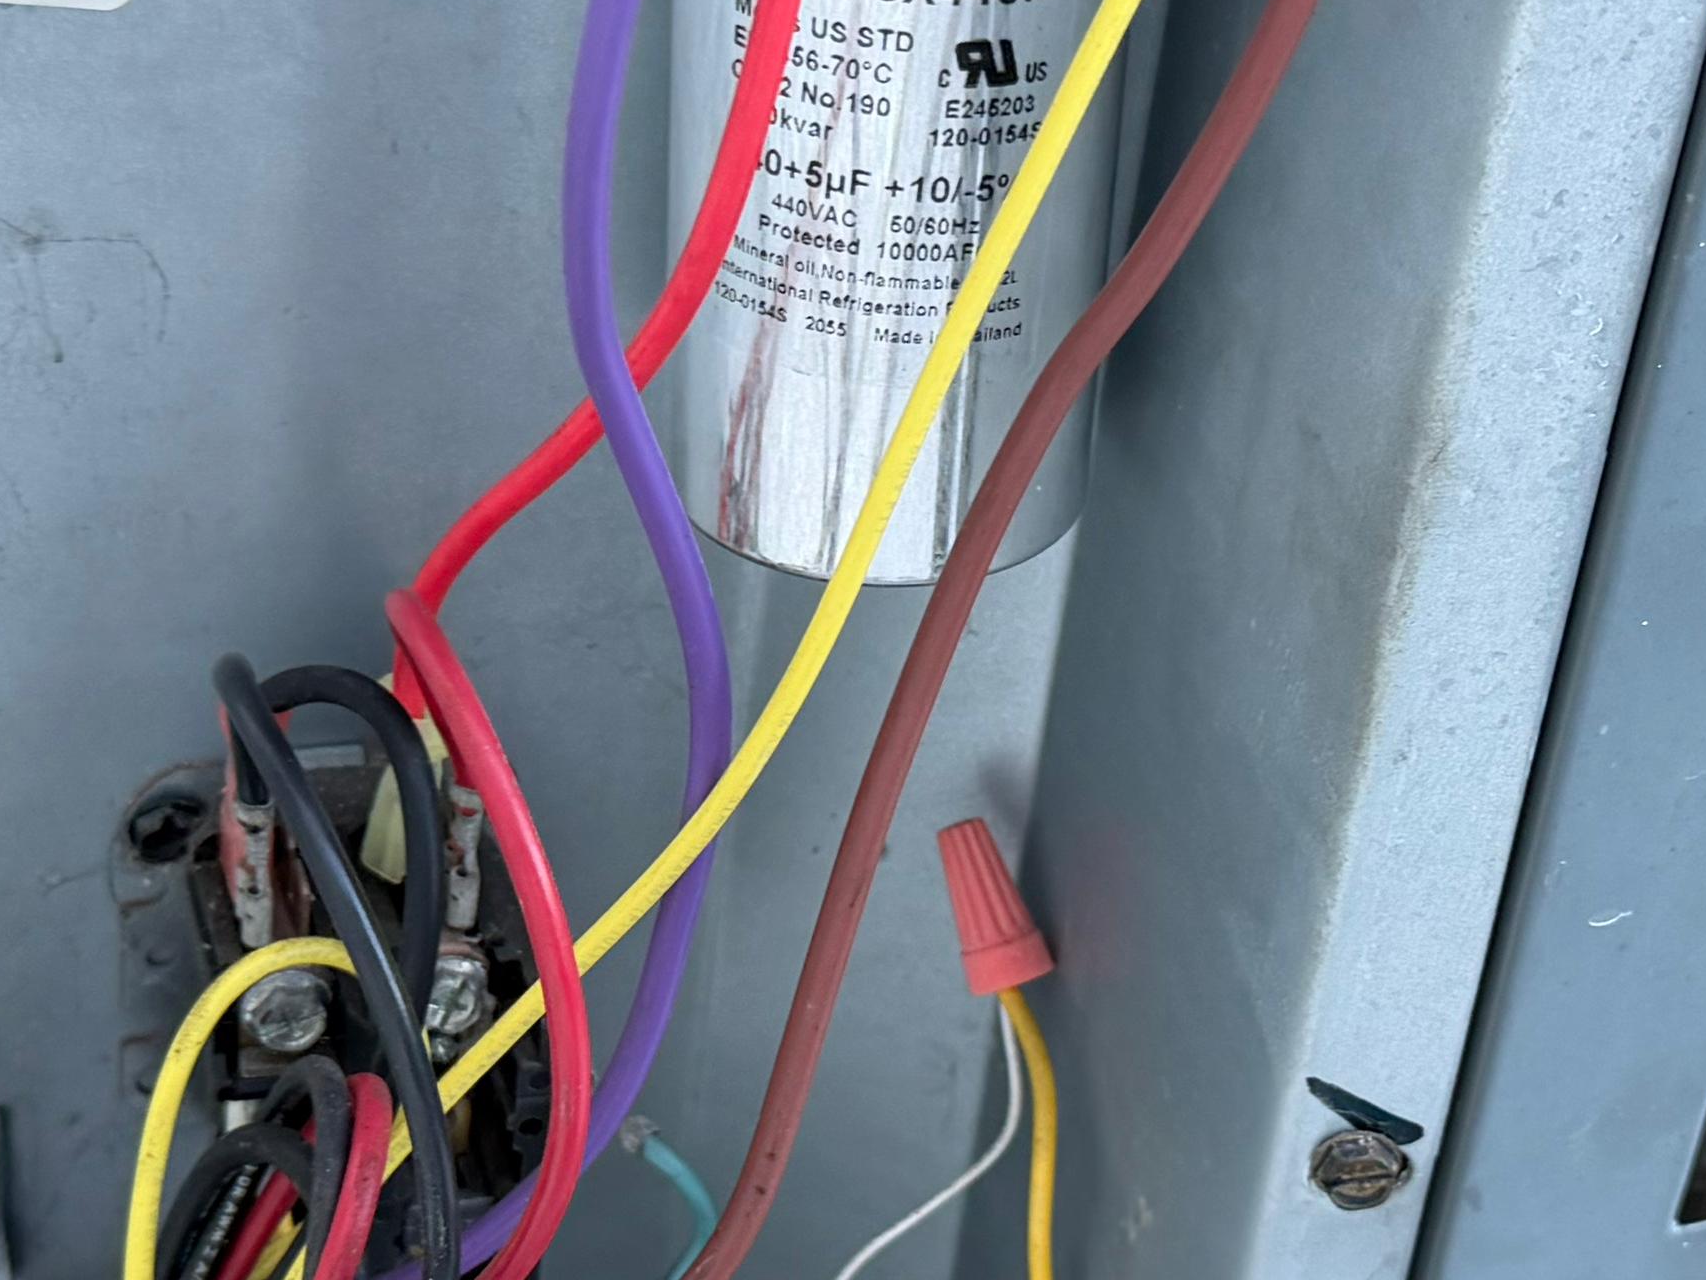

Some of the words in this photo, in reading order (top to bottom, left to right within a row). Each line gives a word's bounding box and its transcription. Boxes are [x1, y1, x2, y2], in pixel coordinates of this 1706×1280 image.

[811, 16, 847, 43] US
[857, 26, 914, 52] STD
[757, 149, 872, 199] 0+5µF
[771, 193, 858, 228] 440VAC
[733, 234, 789, 269] Mineral
[758, 214, 860, 256] Protected
[877, 241, 979, 262] 10000AF
[722, 260, 813, 302] nternational
[818, 289, 939, 317] Refrigeration
[874, 327, 923, 345] Made
[972, 322, 1022, 343] ailand
